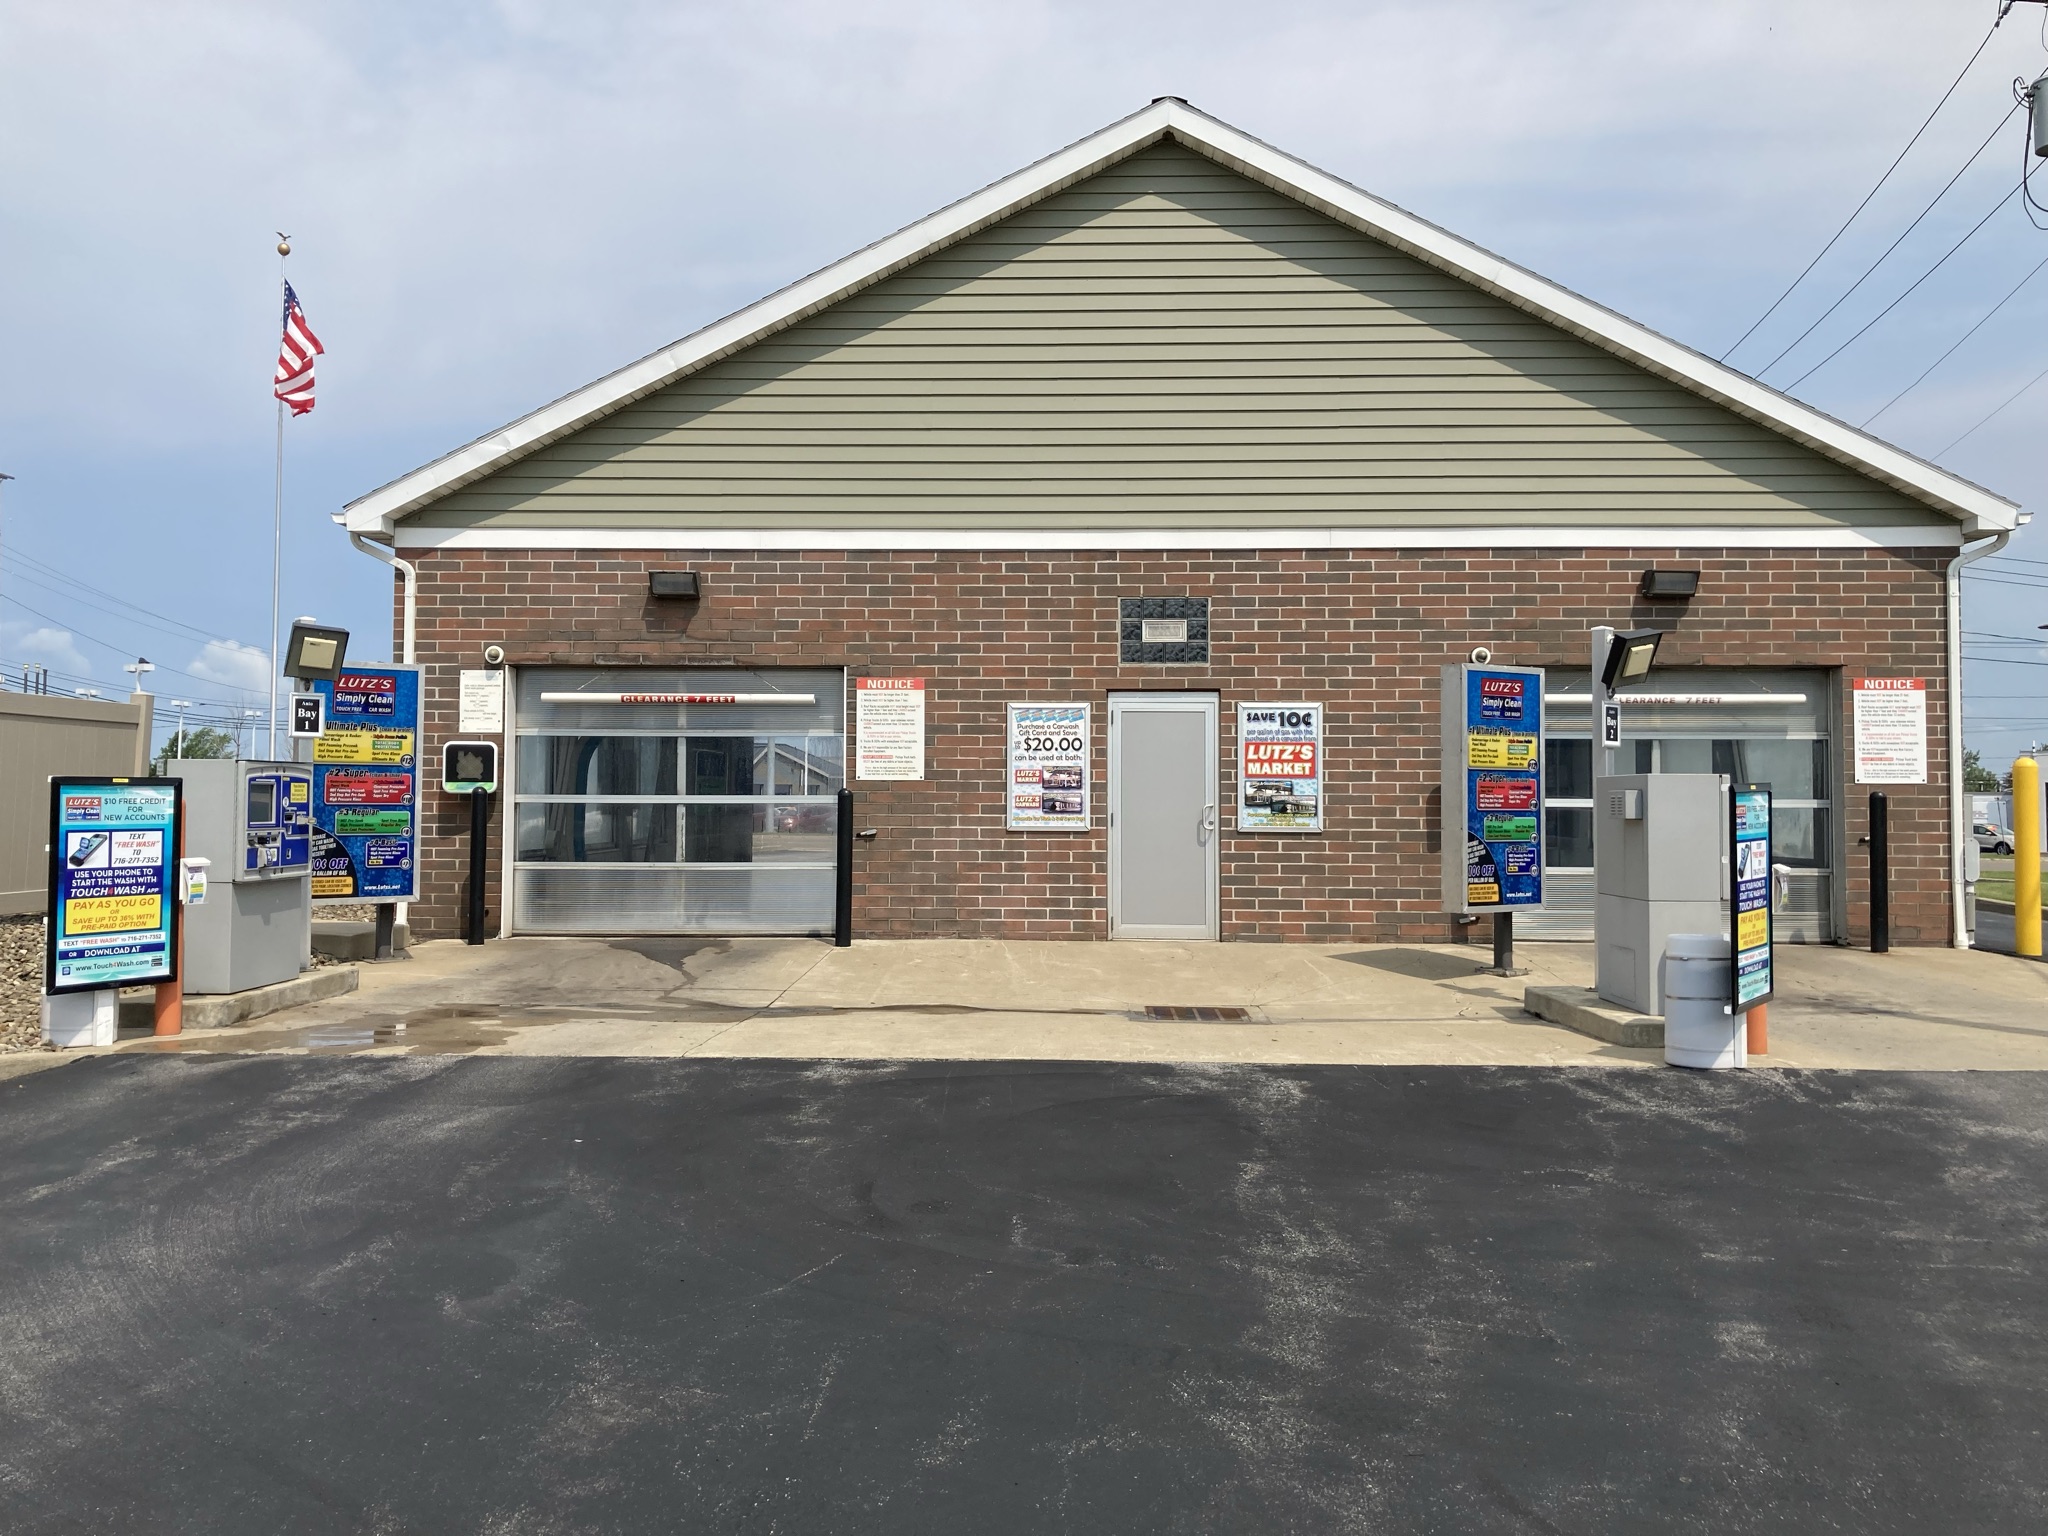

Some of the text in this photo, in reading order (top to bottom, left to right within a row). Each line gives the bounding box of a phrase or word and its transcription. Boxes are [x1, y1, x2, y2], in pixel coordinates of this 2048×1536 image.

[338, 678, 392, 688] LUTZ'S
[867, 679, 915, 689] NOTICE
[1484, 682, 1521, 693] LUTZ'S
[1864, 679, 1915, 689] NOTICE
[336, 692, 393, 704] Simply Clean
[622, 695, 733, 703] CLEARANCE 7 FEET
[1482, 697, 1521, 708] Simply Clean
[297, 708, 317, 719] Bay
[1247, 712, 1312, 727] SAVE 10¢
[1607, 716, 1616, 728] Bay
[304, 721, 309, 730] 1
[326, 721, 378, 732] Ultimate Plus
[1476, 726, 1497, 735] Ultimate
[1499, 726, 1511, 736] Plus
[1610, 730, 1614, 738] 2
[1023, 736, 1083, 753] $20.00
[1247, 744, 1314, 760] LUTZ'S
[344, 769, 368, 778] Super
[1247, 762, 1312, 775] MARKET
[352, 809, 380, 817] Regular
[329, 858, 349, 869] OFF
[1481, 865, 1495, 876] OFF
[72, 879, 96, 887] START
[70, 886, 145, 897] TOUCH4WASH
[73, 898, 155, 910] PAY AS YOU GO
[81, 922, 116, 931] PRE-PAID
[127, 934, 162, 942] 716-271-7352
[85, 946, 130, 957] DOWNLOAD
[76, 960, 149, 971] www.Touch4Wash.com
